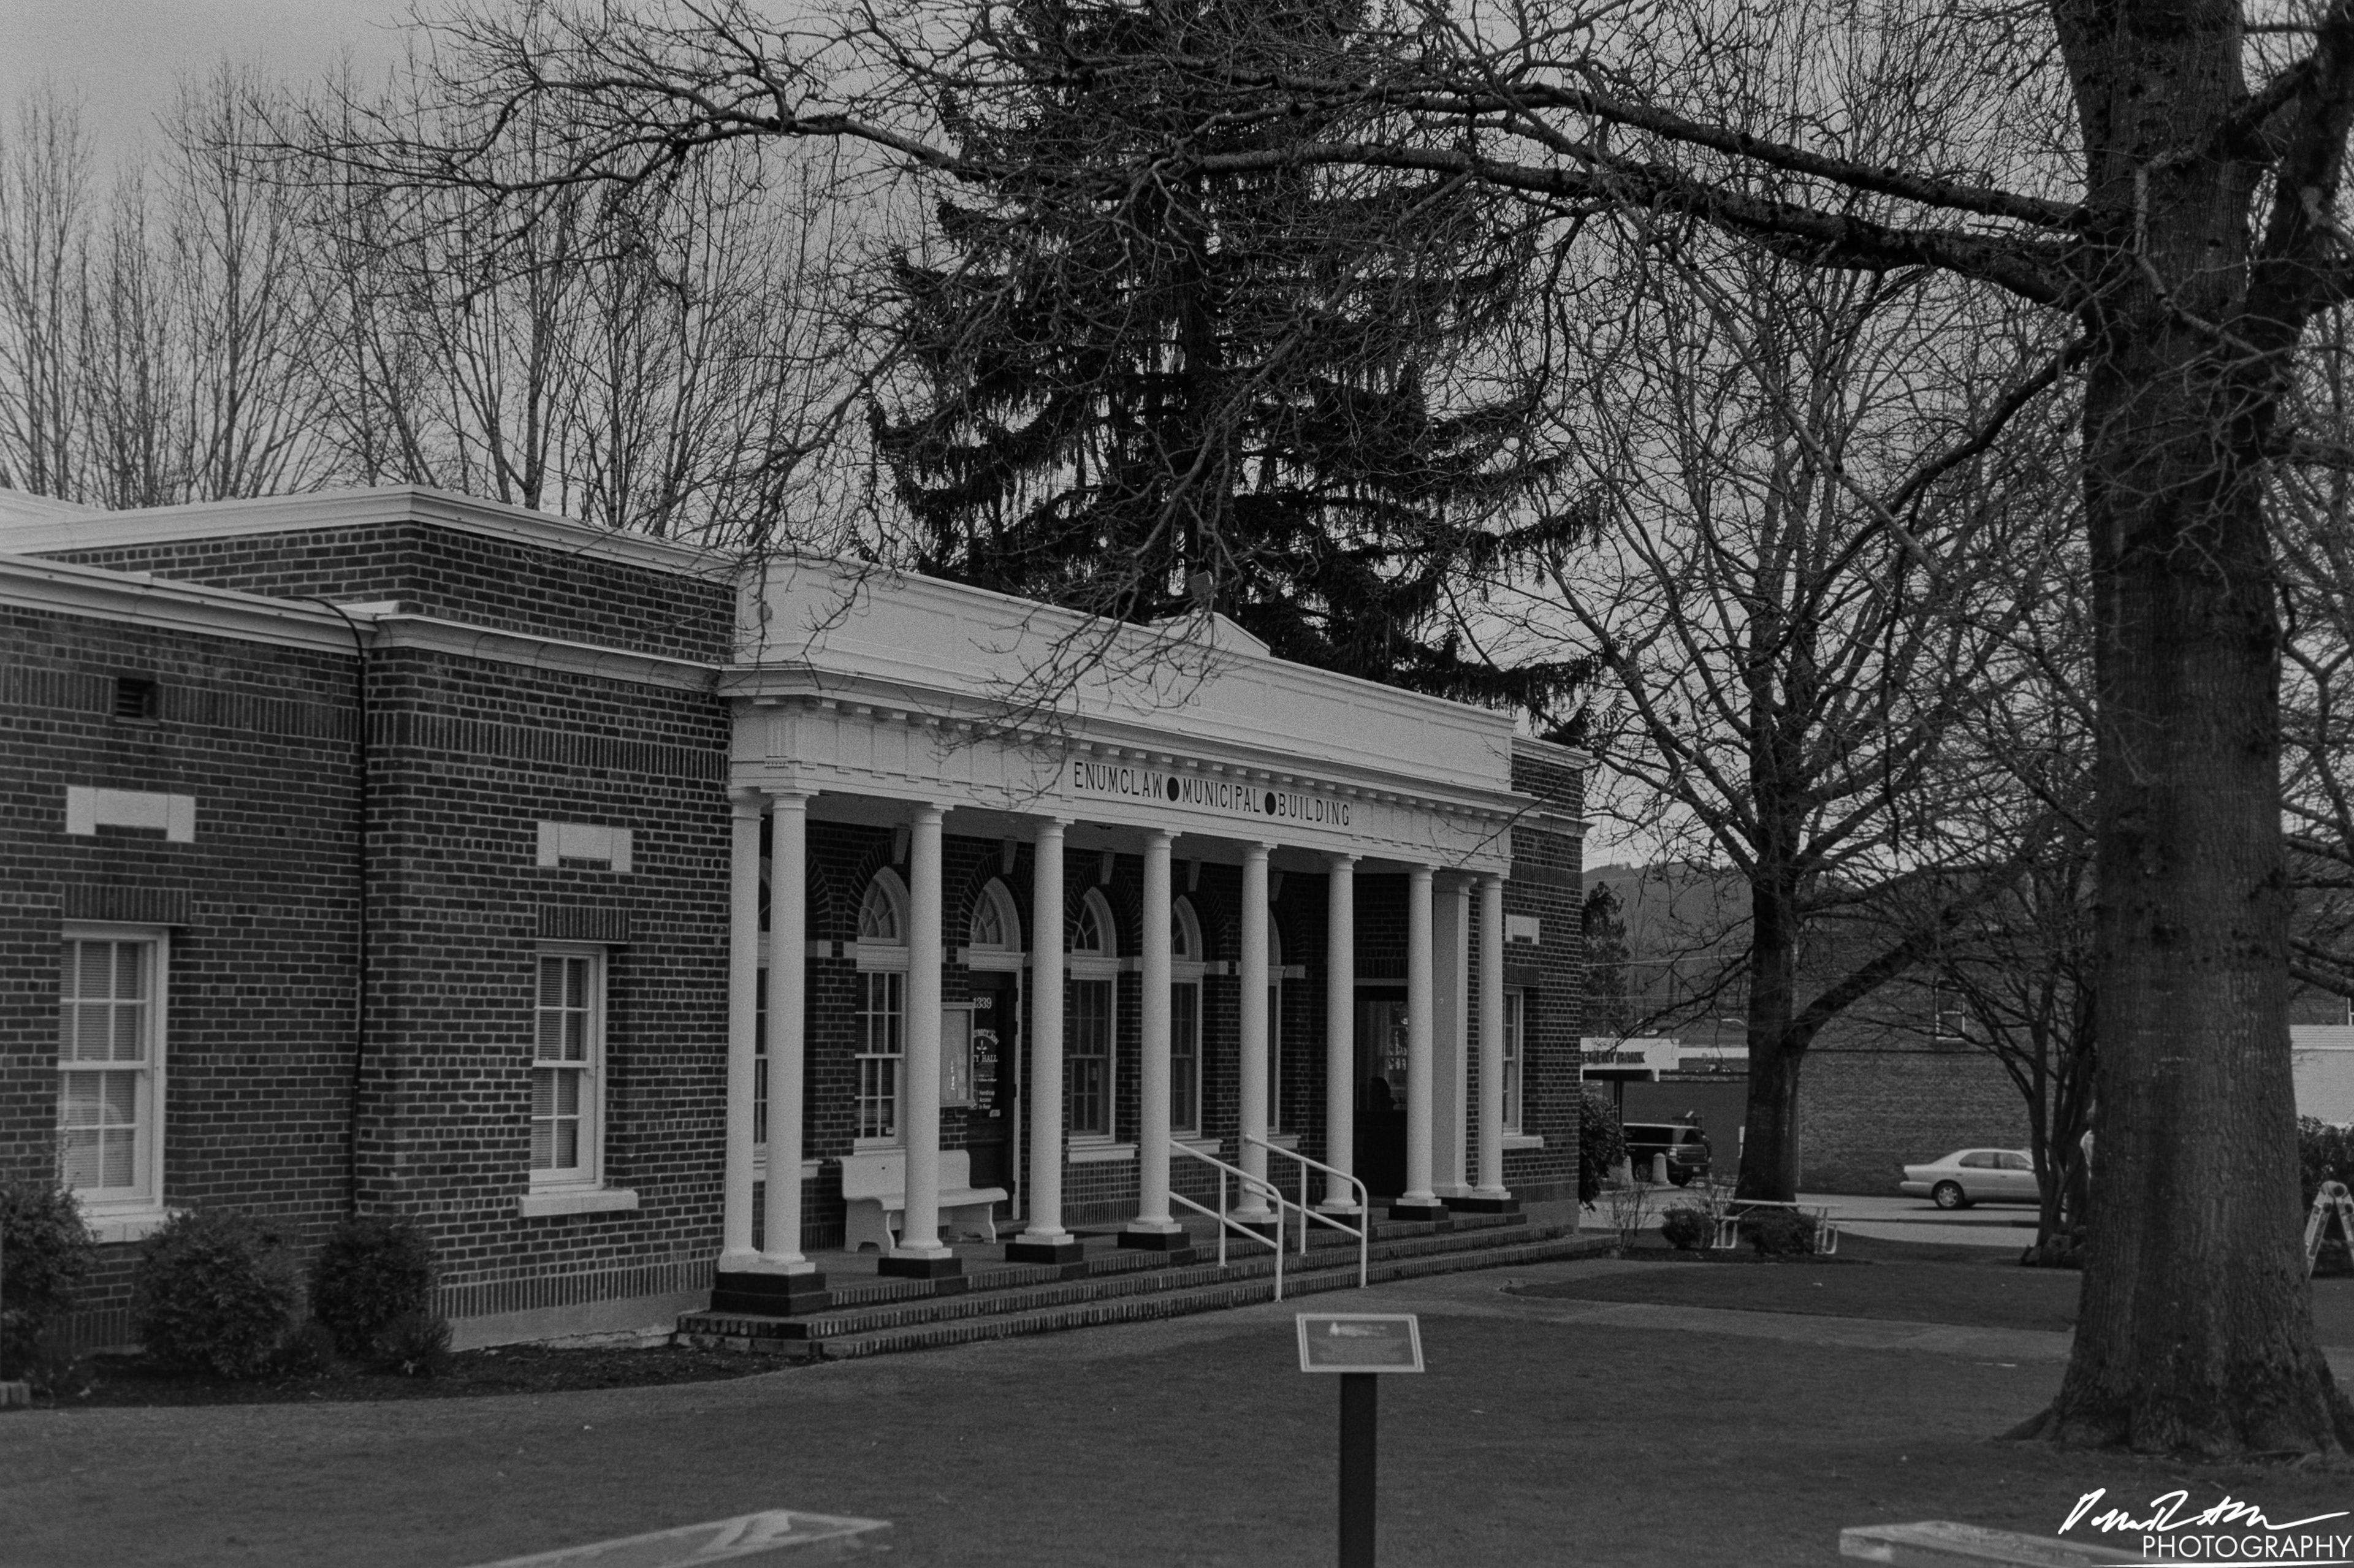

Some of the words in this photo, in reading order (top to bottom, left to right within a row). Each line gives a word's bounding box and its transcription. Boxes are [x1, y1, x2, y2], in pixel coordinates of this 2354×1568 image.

[1075, 761, 1163, 799] ENUMCLAW
[1183, 778, 1260, 813] MUNICIPAL
[1278, 793, 1349, 826] BUILDING
[973, 997, 992, 1009] 1339
[973, 1029, 999, 1045] UMCLAW
